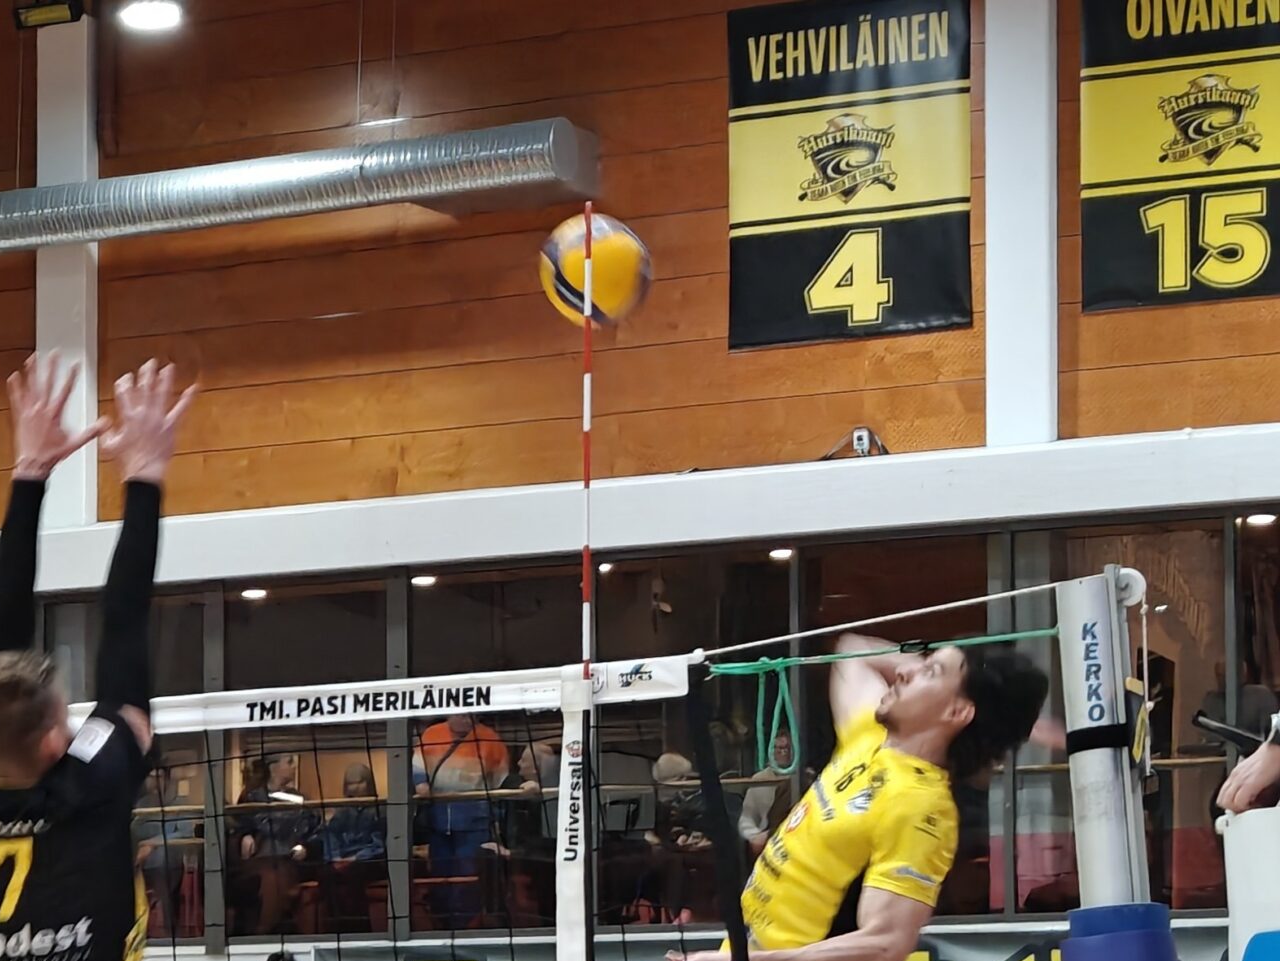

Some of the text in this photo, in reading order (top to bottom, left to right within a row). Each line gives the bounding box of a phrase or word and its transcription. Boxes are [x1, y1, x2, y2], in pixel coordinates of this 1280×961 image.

[748, 11, 949, 83] VEHVILÄINEN
[804, 228, 892, 325] 4
[1140, 188, 1270, 292] 15
[247, 684, 492, 722] TMI. PASI MERILÄINEN
[1081, 621, 1105, 723] KERKO
[563, 762, 583, 862] Universal
